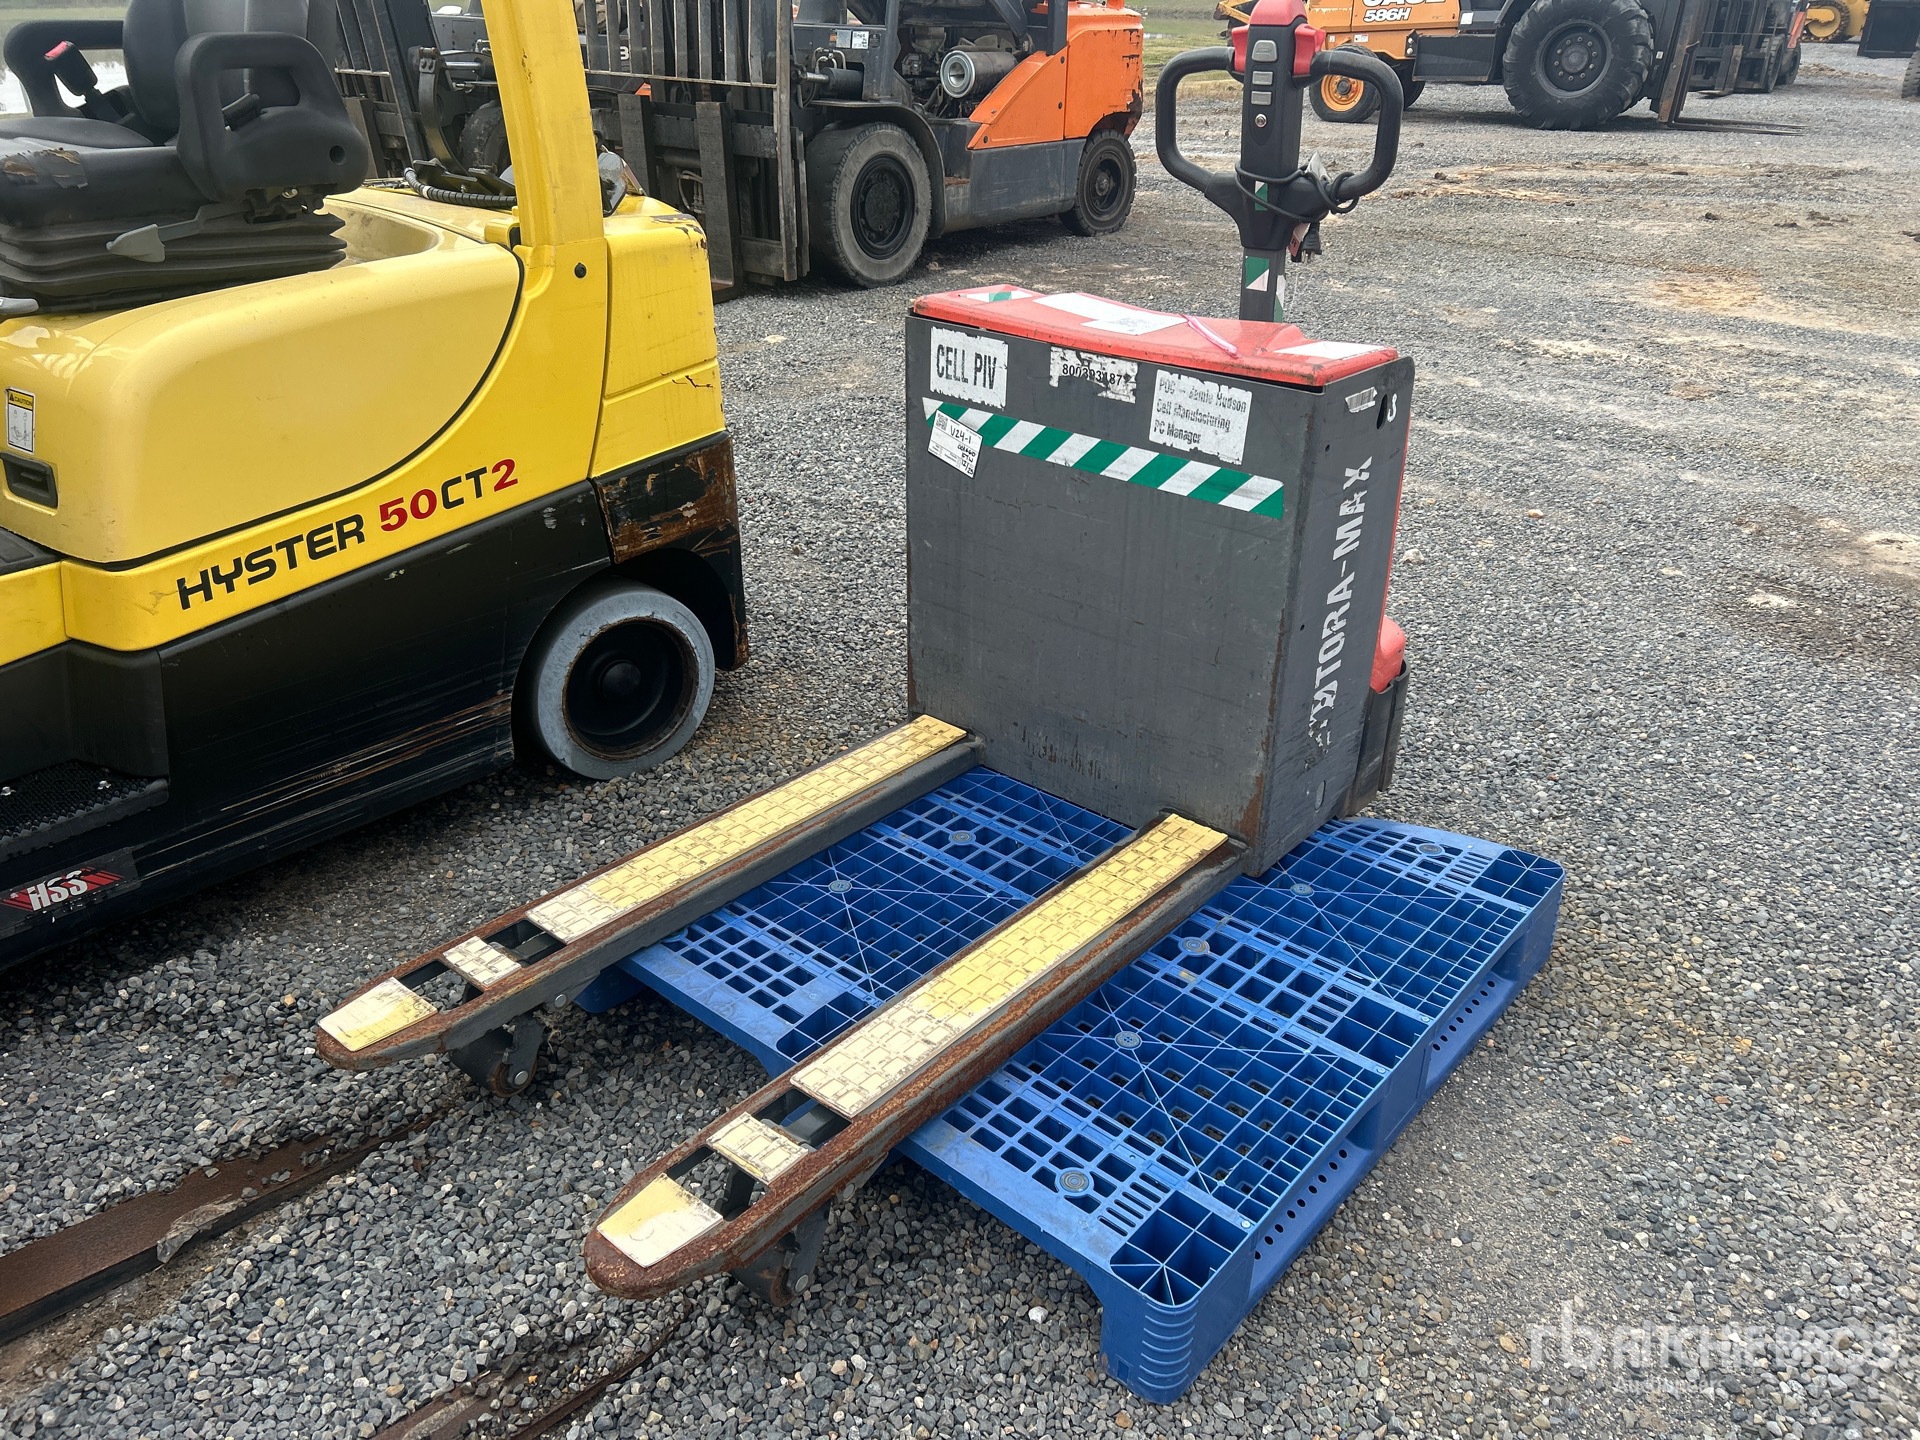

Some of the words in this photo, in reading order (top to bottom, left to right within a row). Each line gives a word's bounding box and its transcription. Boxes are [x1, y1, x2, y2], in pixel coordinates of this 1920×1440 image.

[1363, 7, 1412, 22] 586H
[937, 344, 968, 383] CELL
[973, 352, 997, 389] PIV
[1156, 398, 1172, 415] Cell
[1173, 402, 1231, 433] Manufacturing
[1216, 392, 1247, 413] Hudson
[950, 424, 972, 444] V24-1
[1154, 419, 1165, 434] PC
[1166, 423, 1201, 444] Manager
[176, 514, 365, 611] HYSTER
[379, 458, 519, 532] 50CT2
[27, 870, 88, 911] HSS
